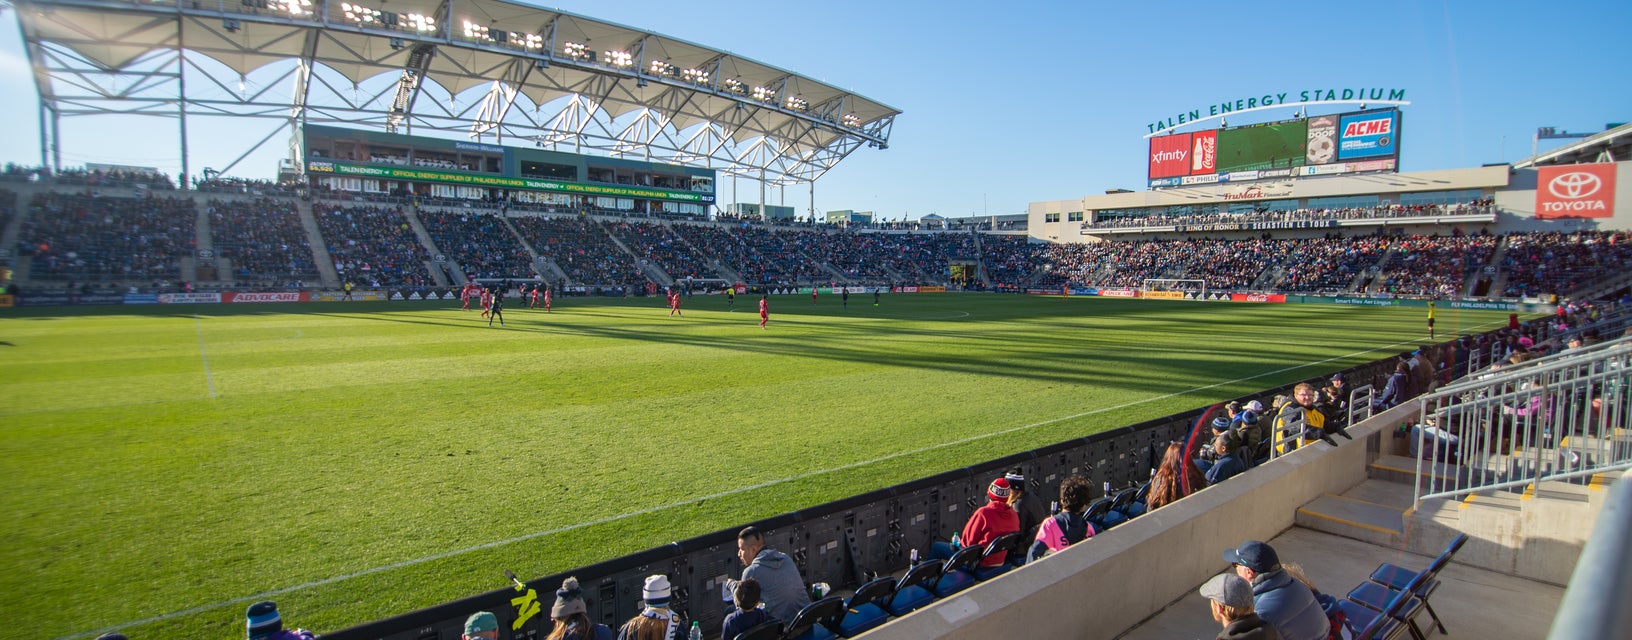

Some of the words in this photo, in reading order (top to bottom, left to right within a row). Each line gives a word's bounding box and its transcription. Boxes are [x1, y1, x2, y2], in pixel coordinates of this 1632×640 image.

[1148, 109, 1199, 134] TALEN
[1210, 93, 1287, 116] ENERGY
[1300, 88, 1405, 102] STADIUM
[1345, 119, 1391, 137] ACME
[1152, 149, 1188, 164] xfinity
[393, 170, 416, 178] OFFICIAL
[1196, 175, 1218, 183] PHILLY
[1223, 190, 1263, 201] TruMark
[1542, 200, 1605, 212] TOYOTA
[232, 292, 300, 302] ADVOCARE
